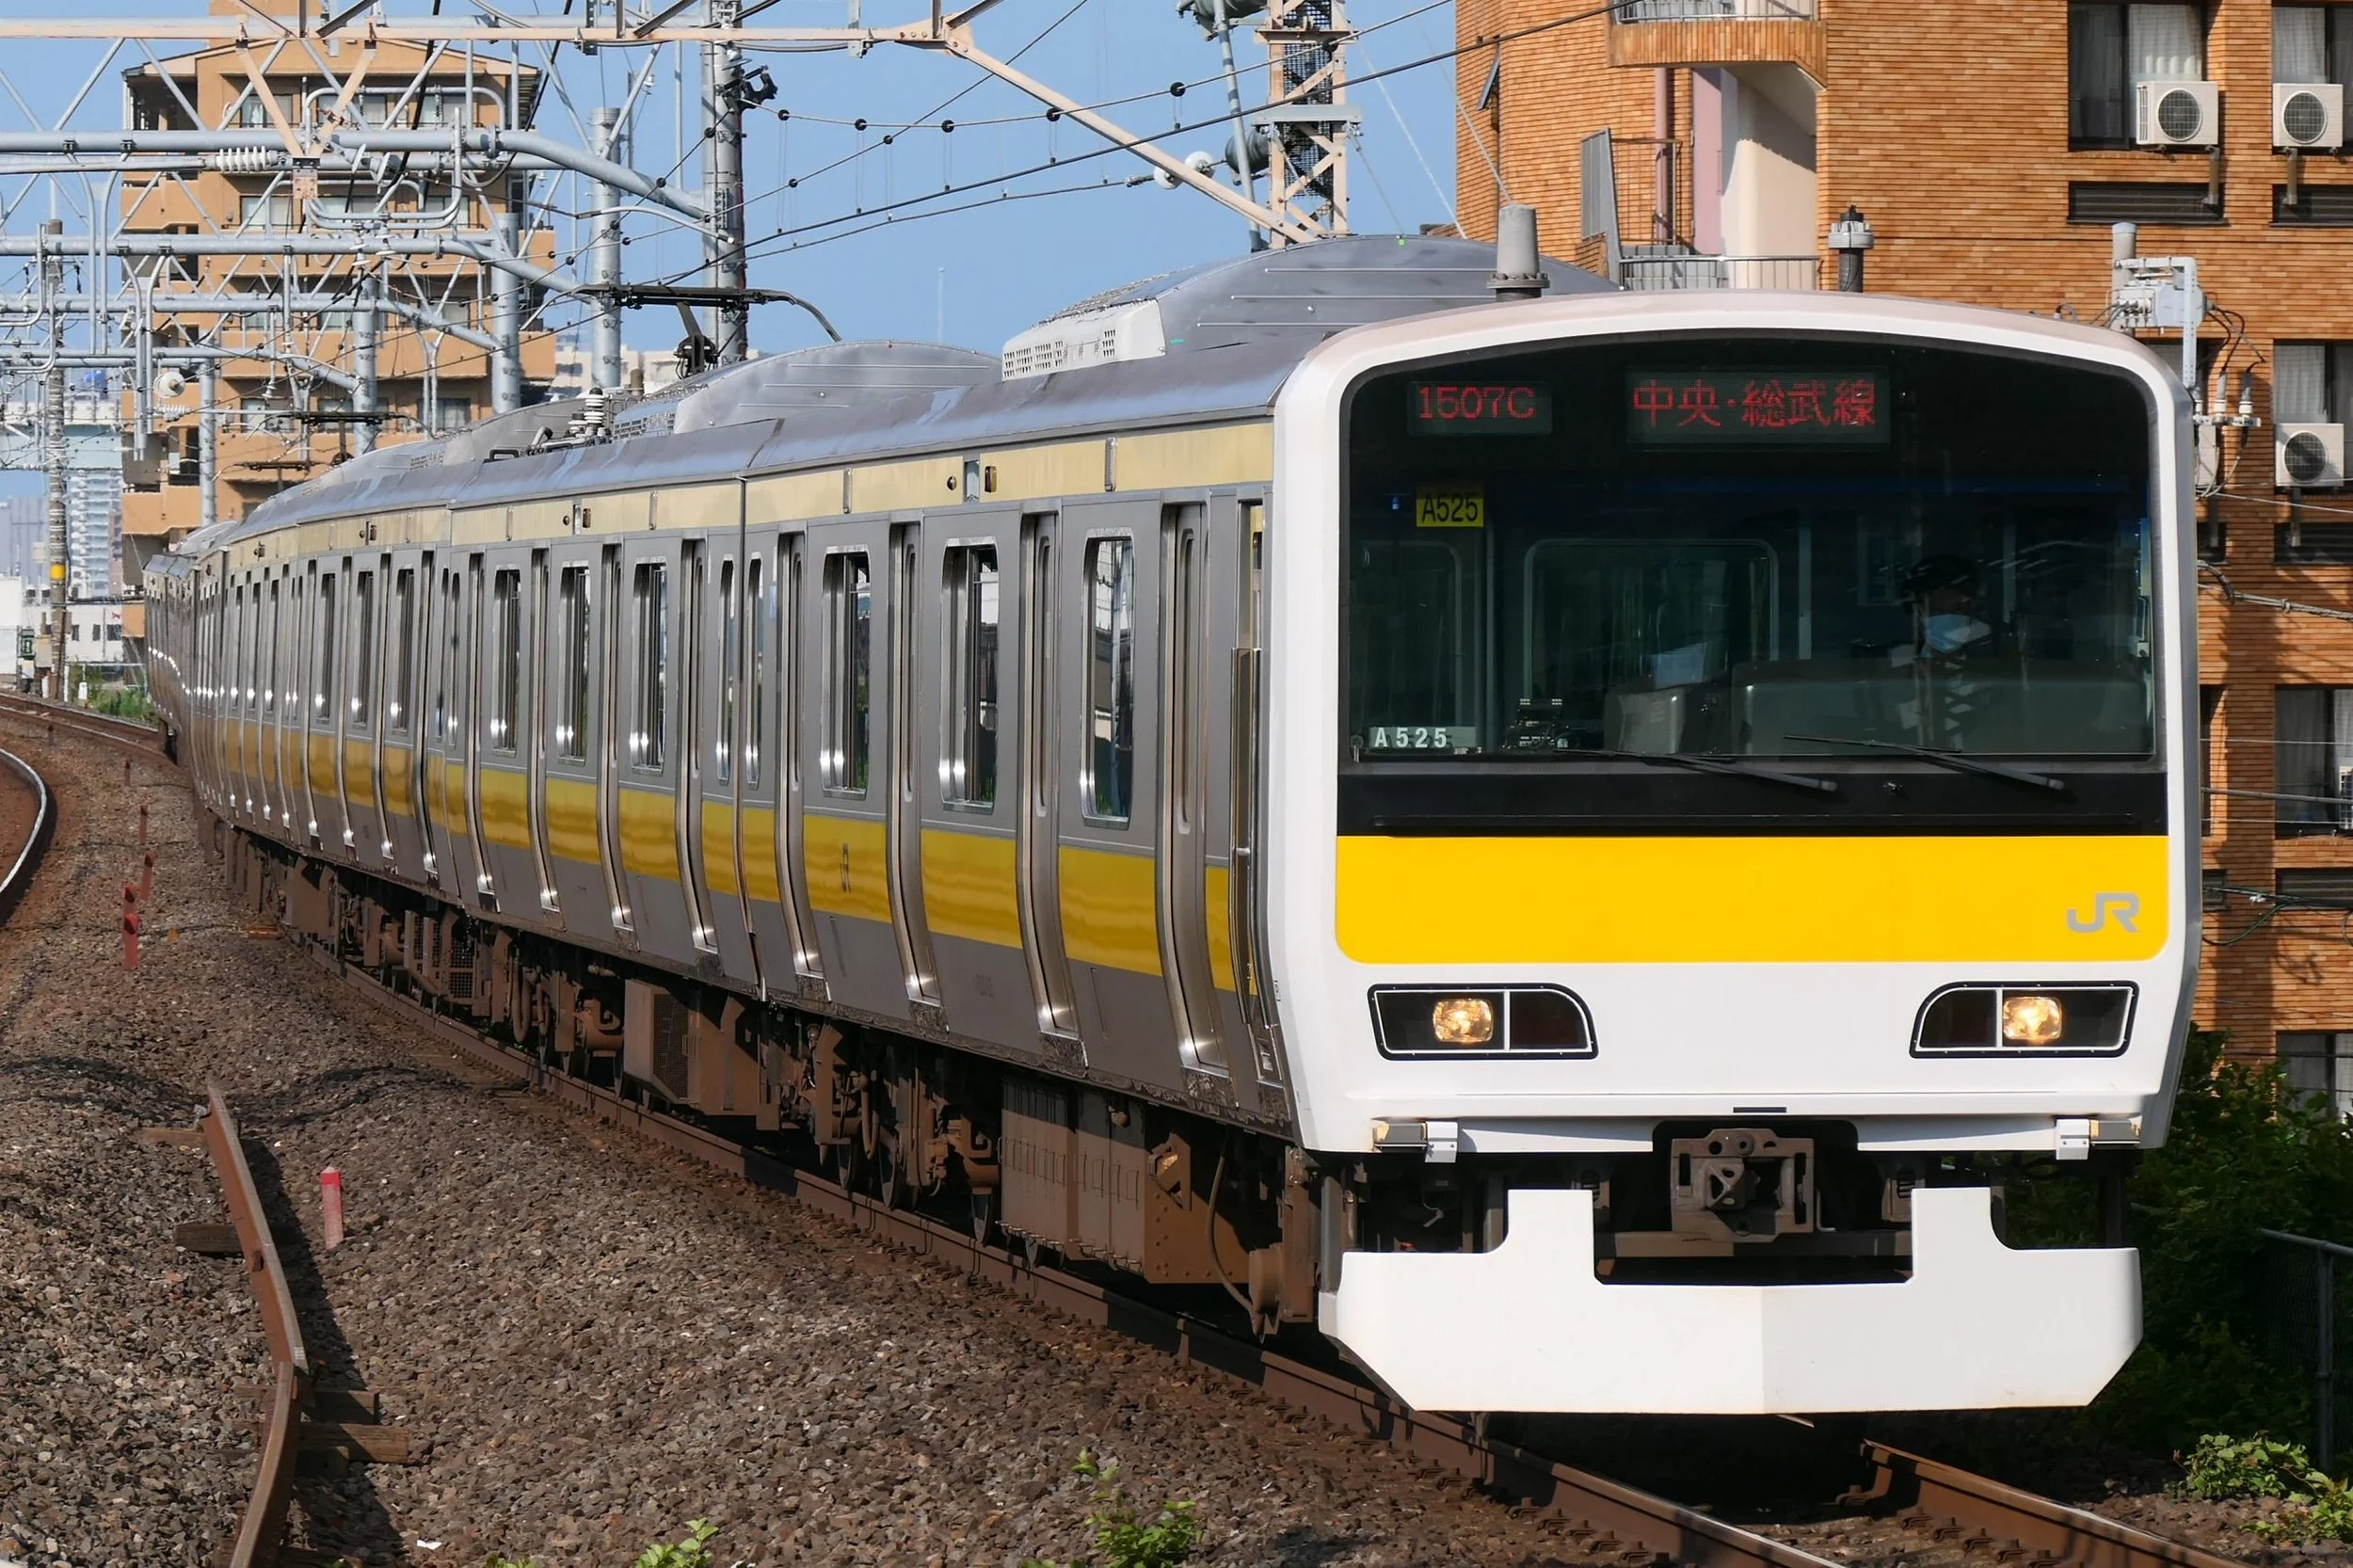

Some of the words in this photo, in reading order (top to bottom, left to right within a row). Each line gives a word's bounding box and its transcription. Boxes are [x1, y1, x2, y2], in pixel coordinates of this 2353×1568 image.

[1418, 386, 1536, 419] 1507C
[1421, 492, 1479, 523] A525
[1374, 727, 1448, 748] A525
[2067, 892, 2140, 933] JR
